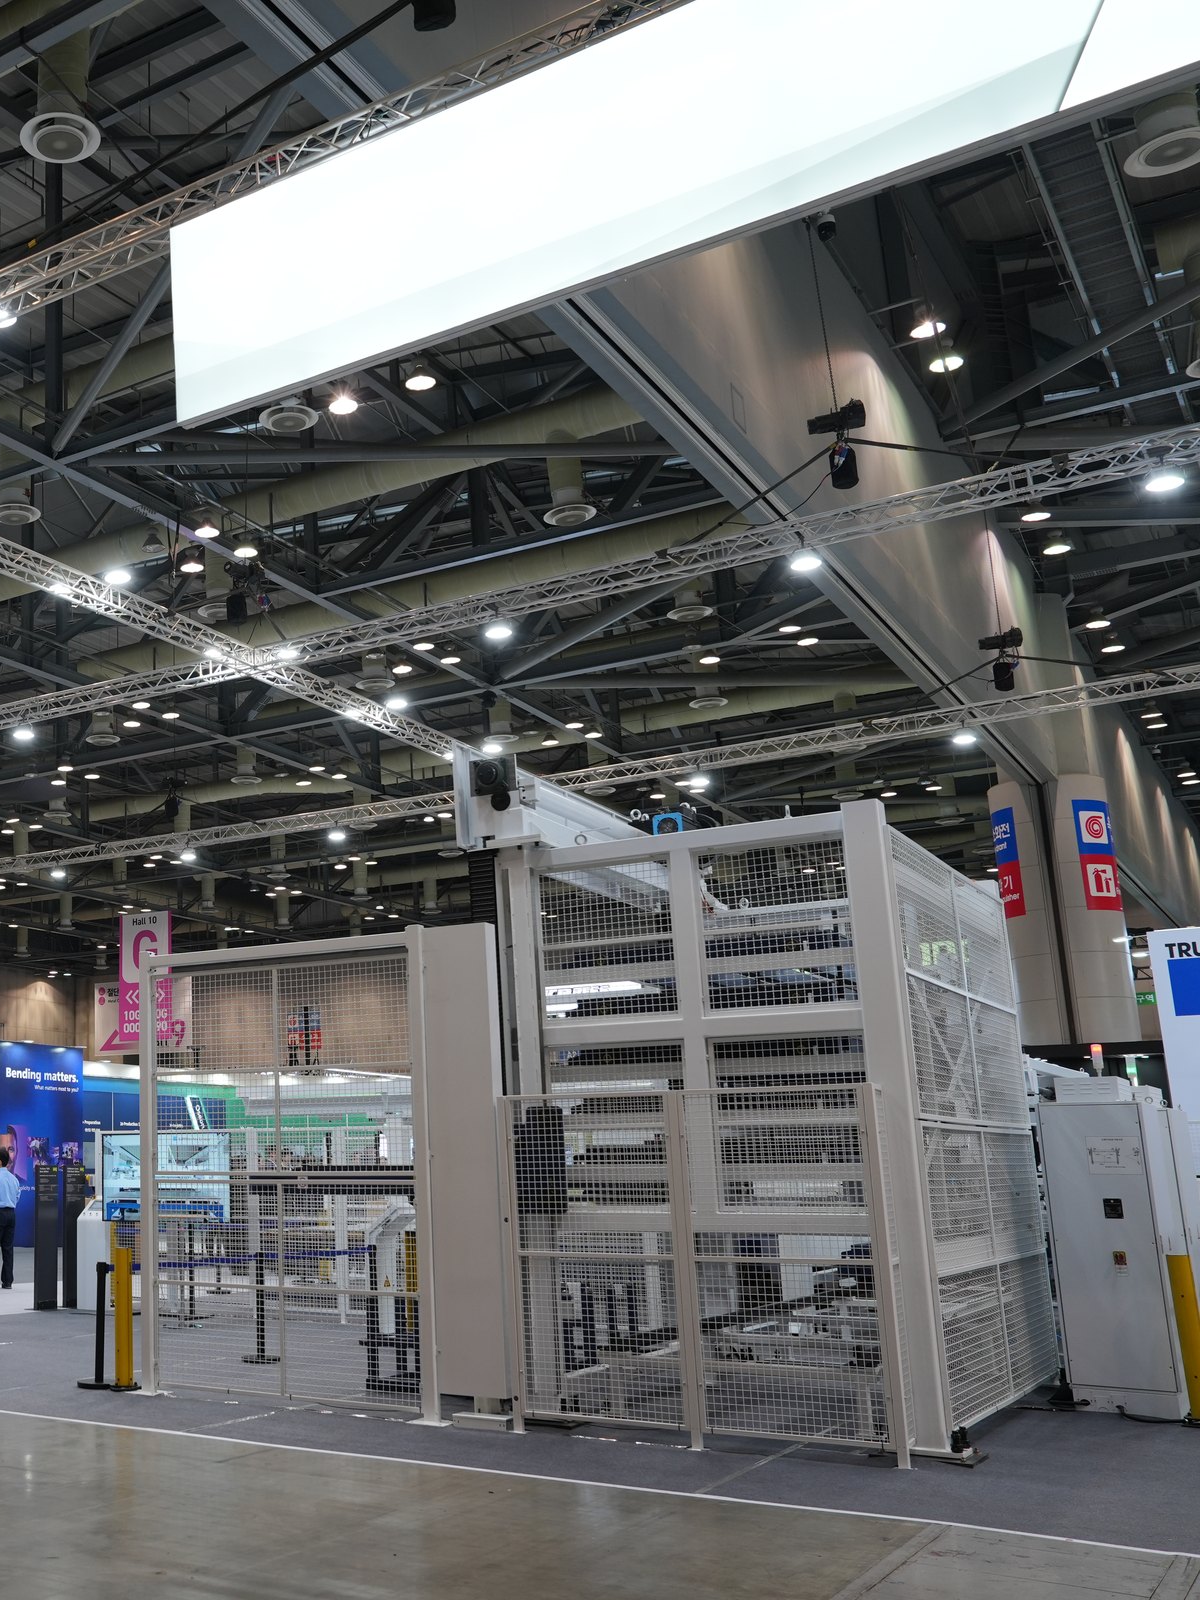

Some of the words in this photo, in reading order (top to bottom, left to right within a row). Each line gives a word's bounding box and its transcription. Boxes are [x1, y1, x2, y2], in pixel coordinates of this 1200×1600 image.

[132, 917, 146, 926] Hall
[148, 916, 157, 925] 10
[133, 930, 158, 970] G
[6, 1067, 41, 1082] Bending
[44, 1071, 78, 1083] matters.
